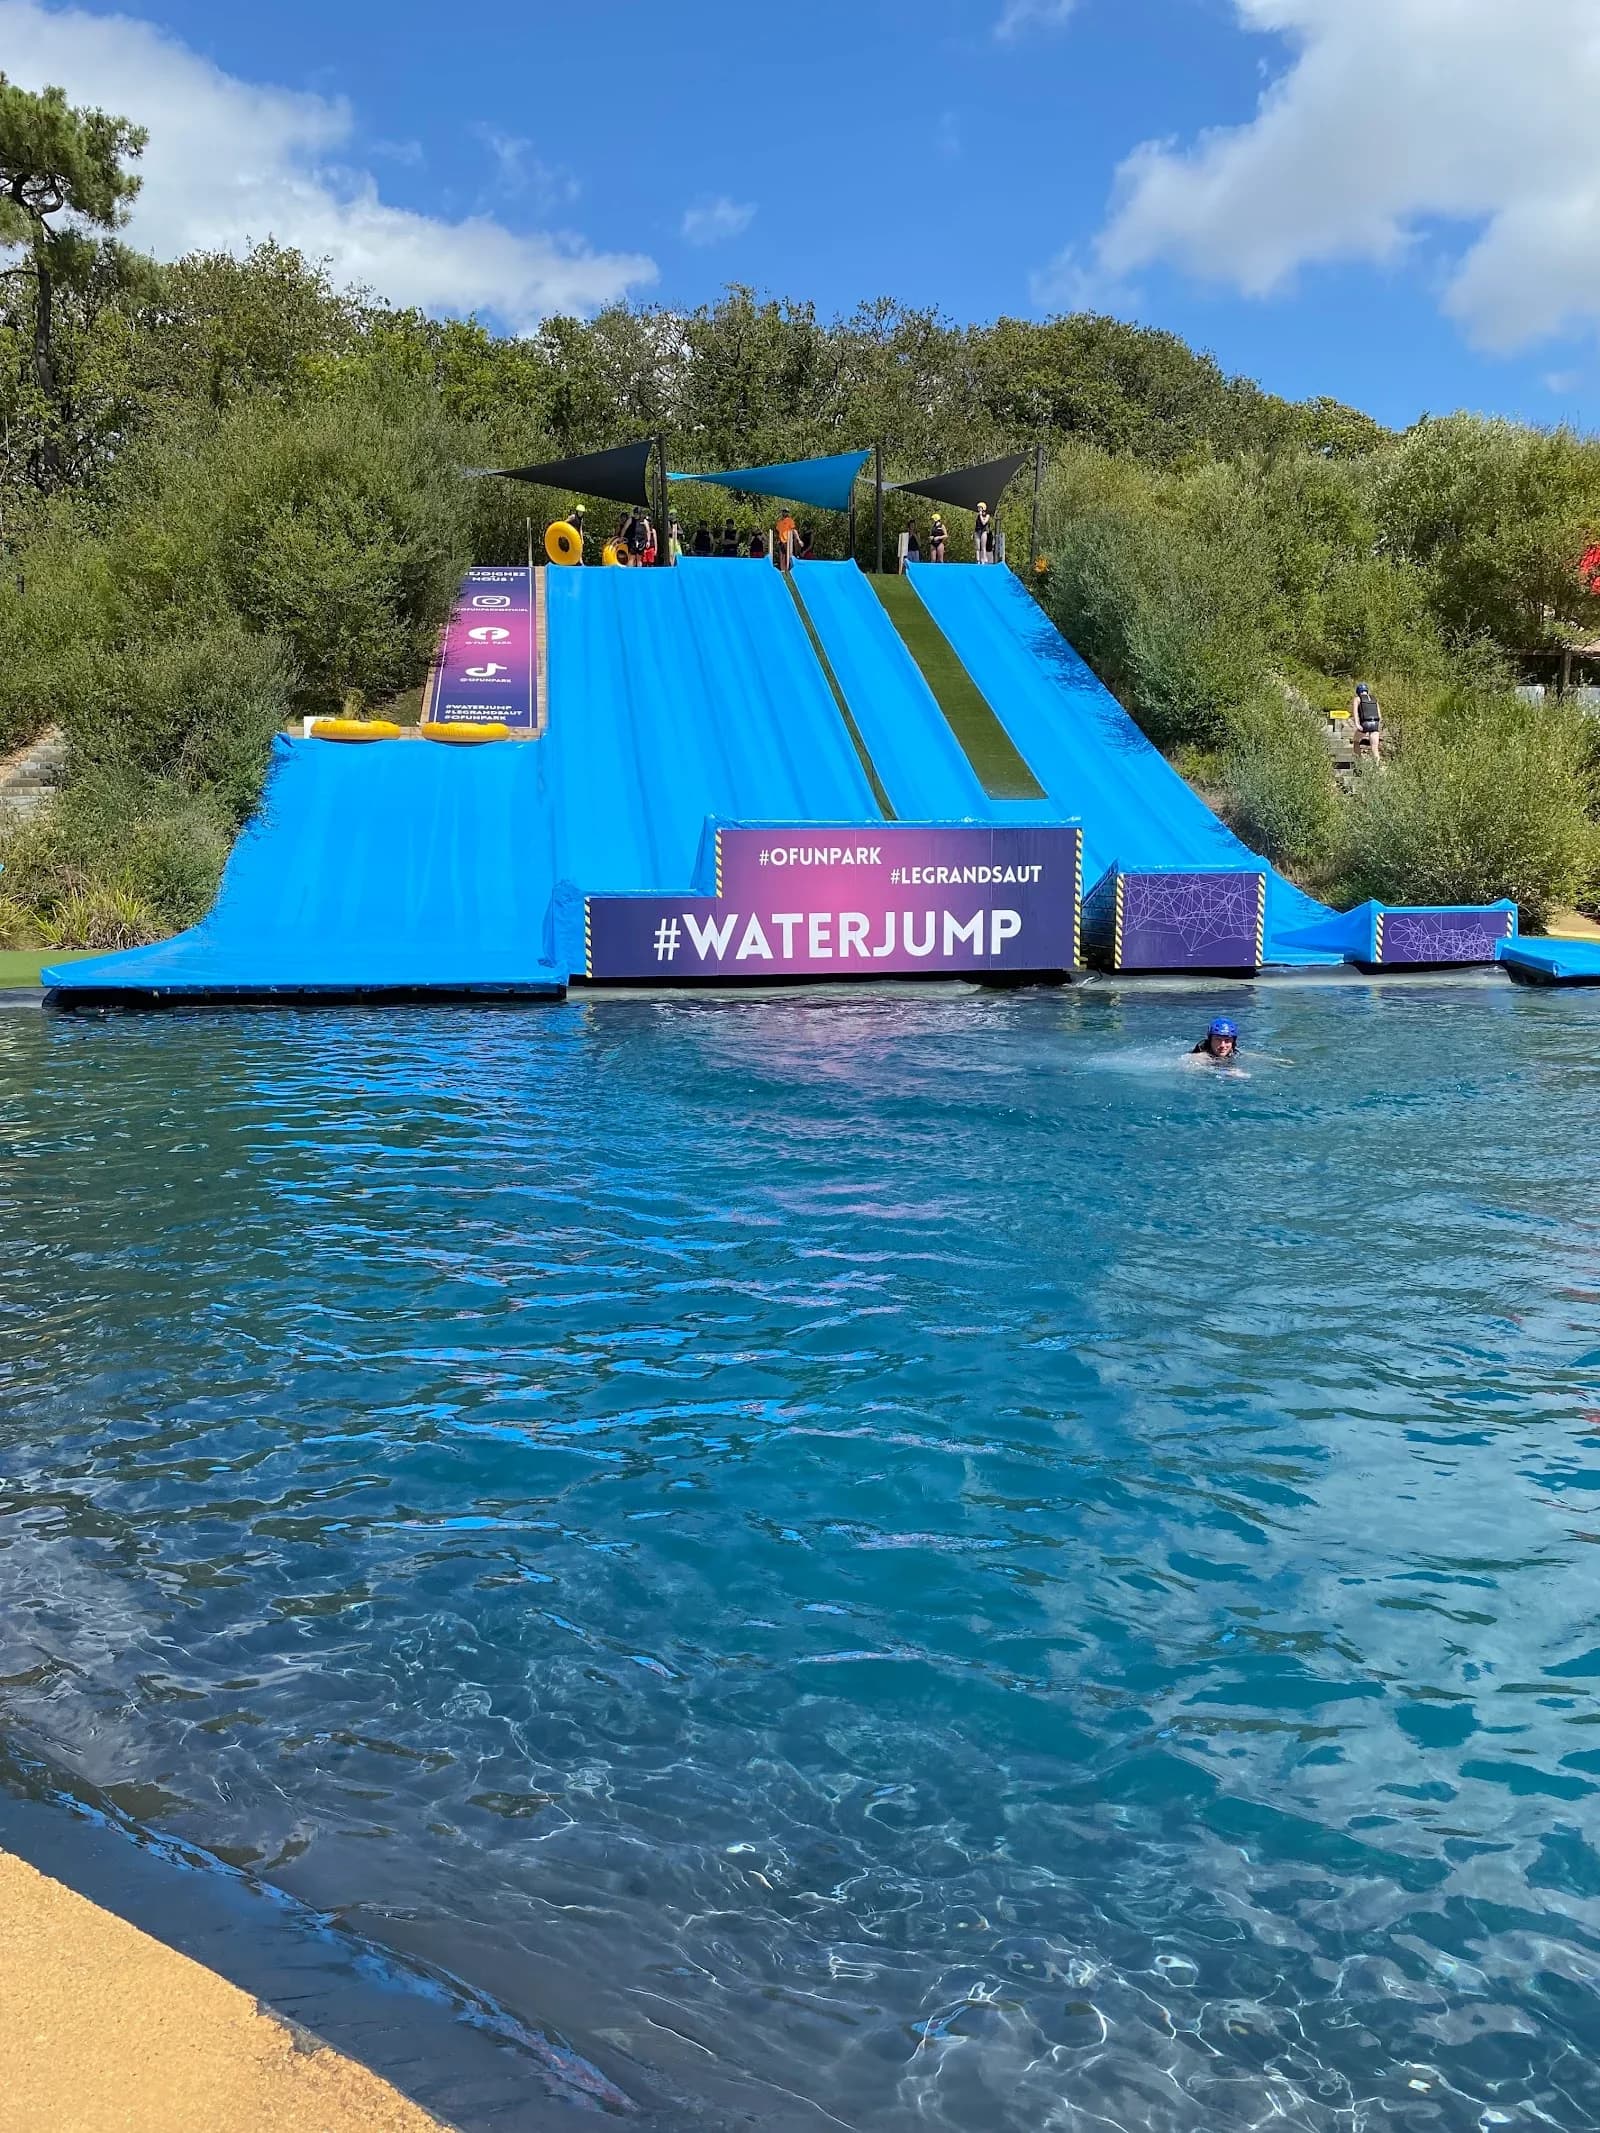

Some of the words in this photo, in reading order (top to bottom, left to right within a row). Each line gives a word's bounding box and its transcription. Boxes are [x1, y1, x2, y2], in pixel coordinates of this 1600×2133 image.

[758, 847, 882, 866] #OFUNPARK
[890, 865, 1042, 885] #LEGRANDSAUT
[653, 909, 1023, 961] #WATERJUMP
